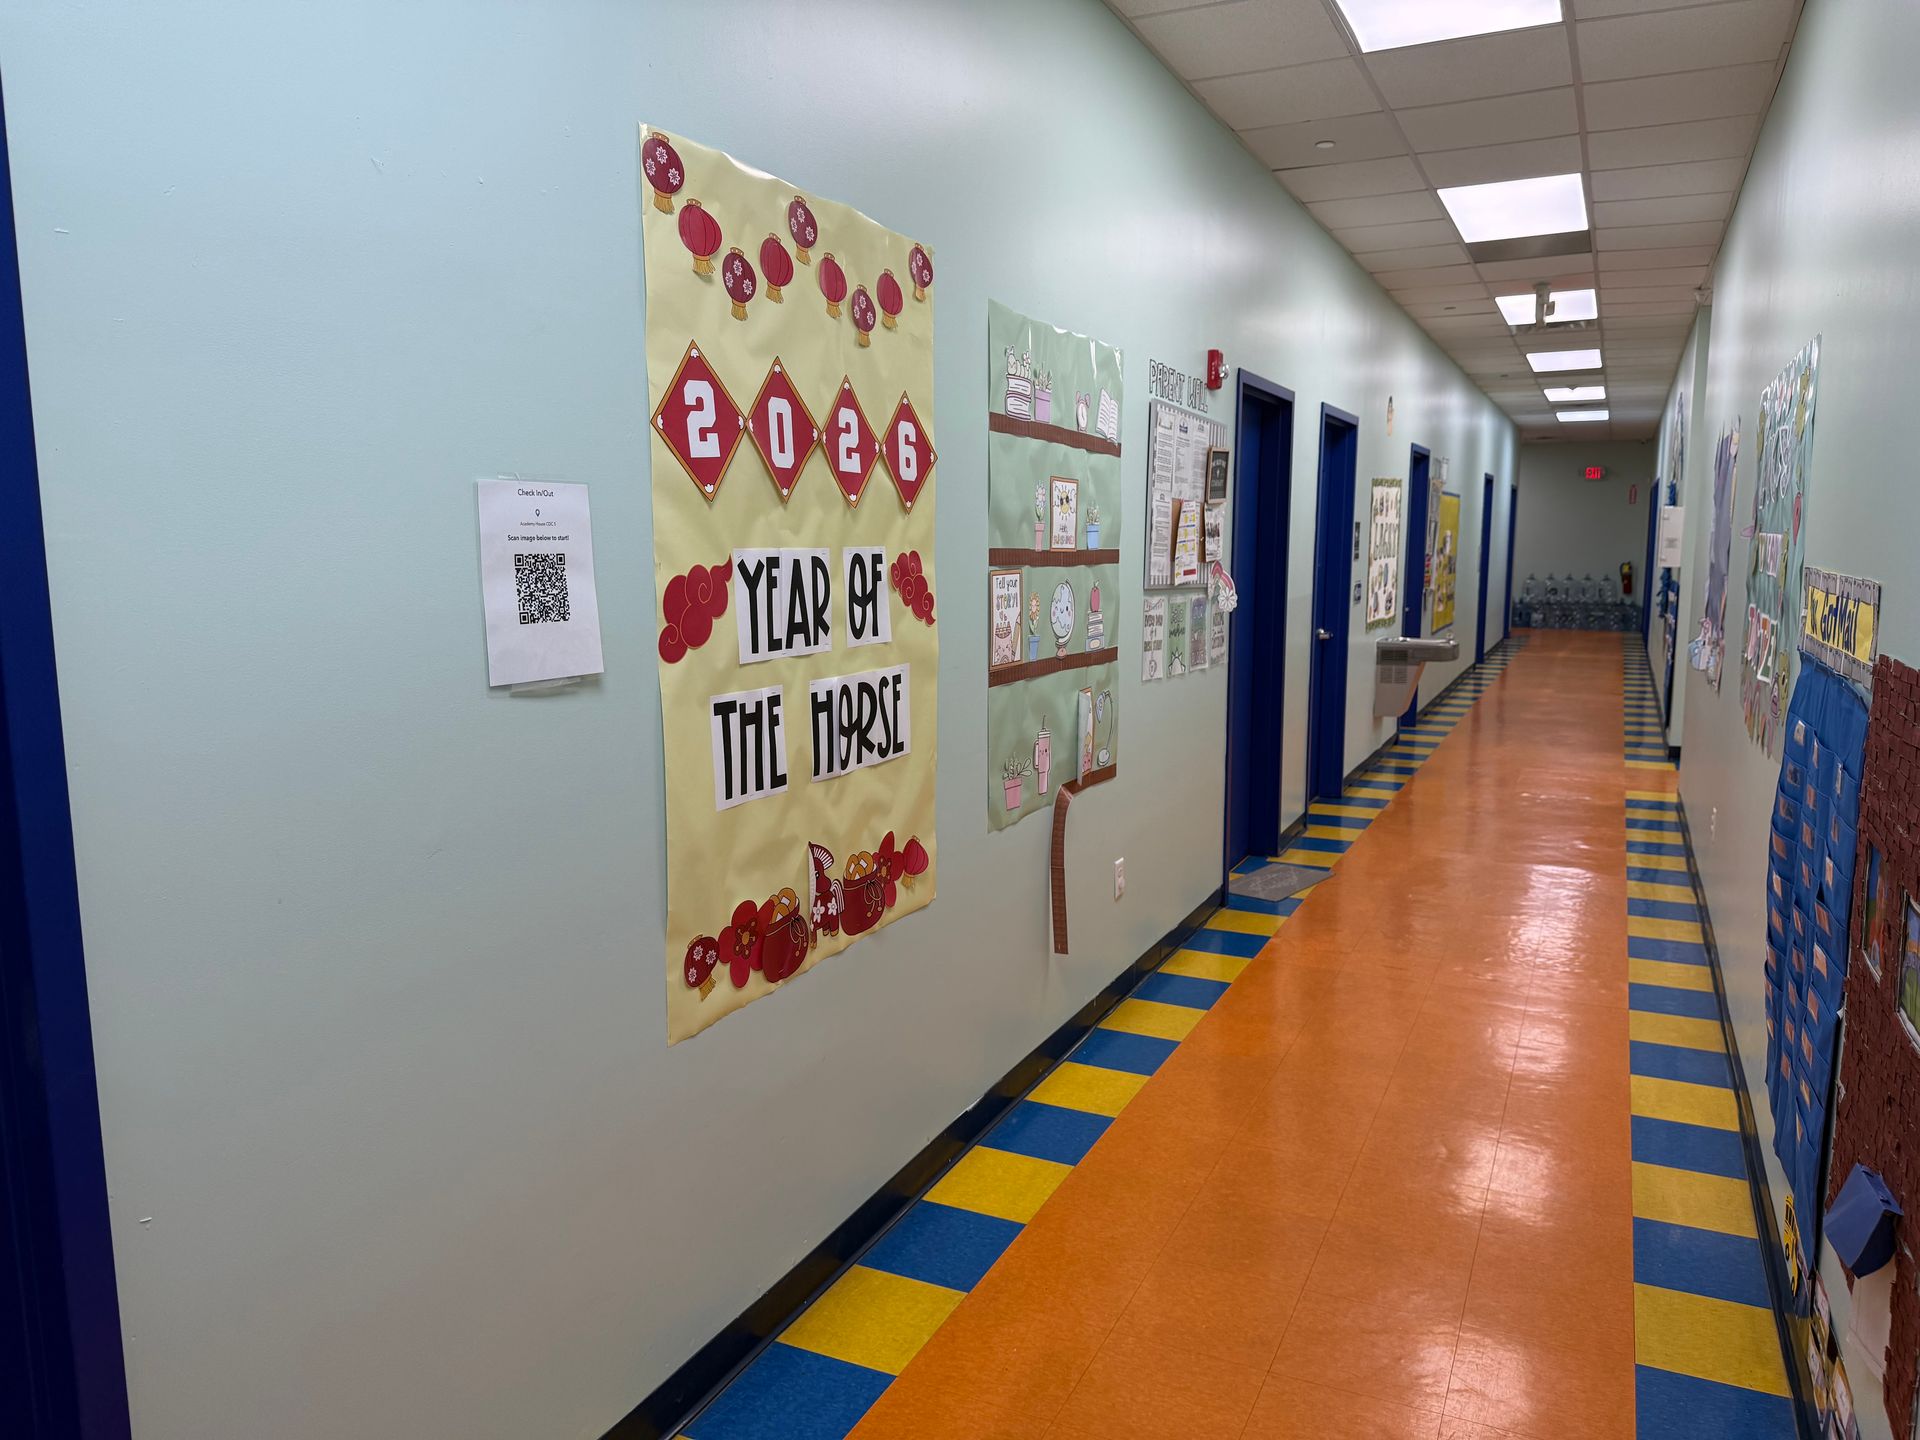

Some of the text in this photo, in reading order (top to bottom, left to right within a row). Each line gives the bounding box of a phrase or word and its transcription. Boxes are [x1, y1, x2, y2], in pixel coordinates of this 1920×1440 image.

[1148, 358, 1185, 405] PARENT
[1585, 466, 1602, 480] EXIT
[517, 488, 554, 498] Check In/Out
[520, 534, 536, 543] image
[995, 576, 1006, 590] Tell
[737, 553, 883, 655] YEAR OF
[713, 673, 906, 801] THE HORSE
